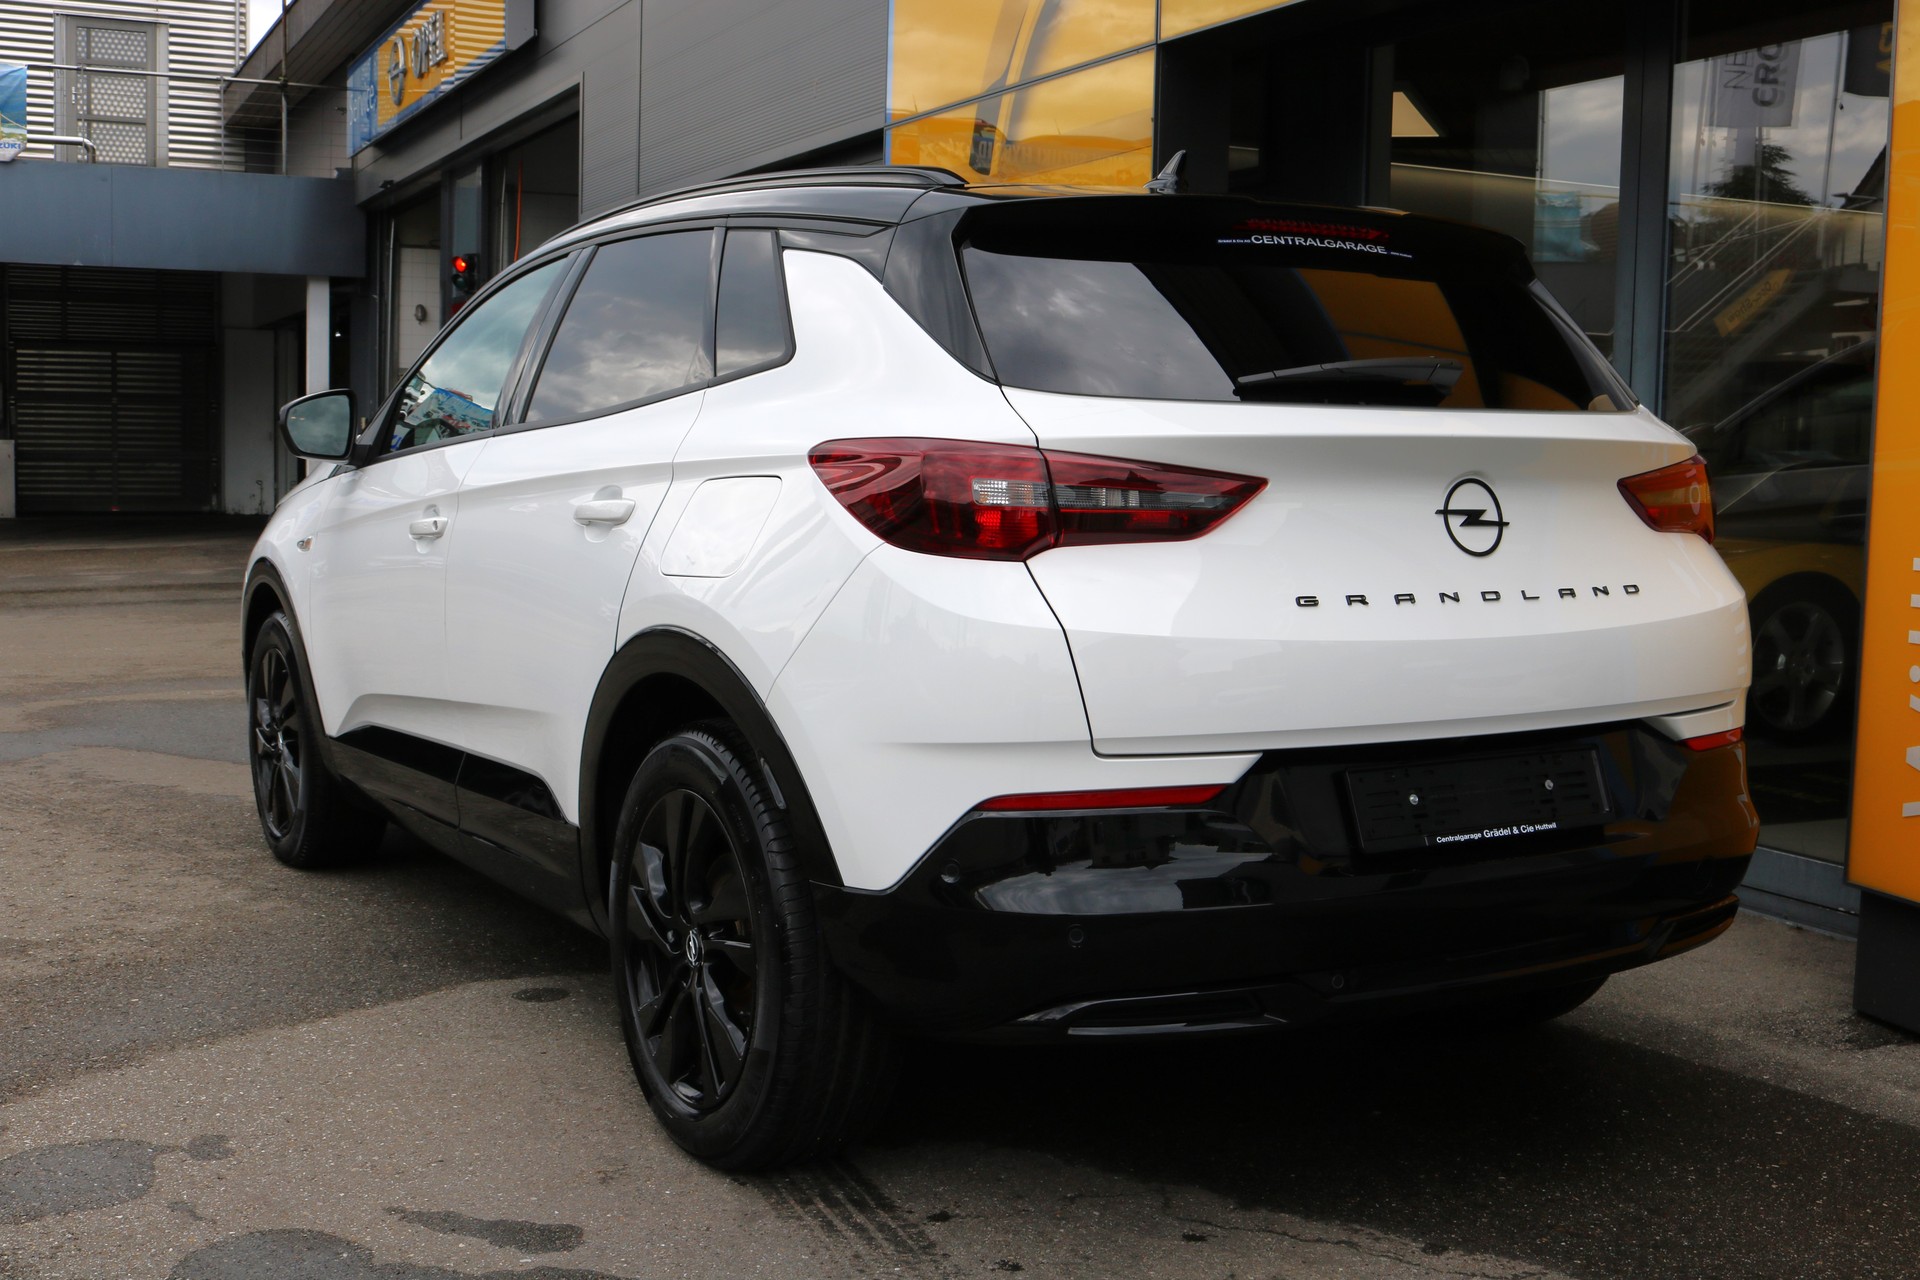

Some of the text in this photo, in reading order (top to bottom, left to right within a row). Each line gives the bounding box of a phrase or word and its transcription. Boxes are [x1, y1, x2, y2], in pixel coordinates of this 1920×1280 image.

[411, 10, 448, 78] OPEL
[1251, 235, 1388, 254] CENTRALGARAGE
[1295, 584, 1640, 607] GRANDLAND
[1436, 822, 1557, 843] Centralgarage Grädel & Cie Huttwil
